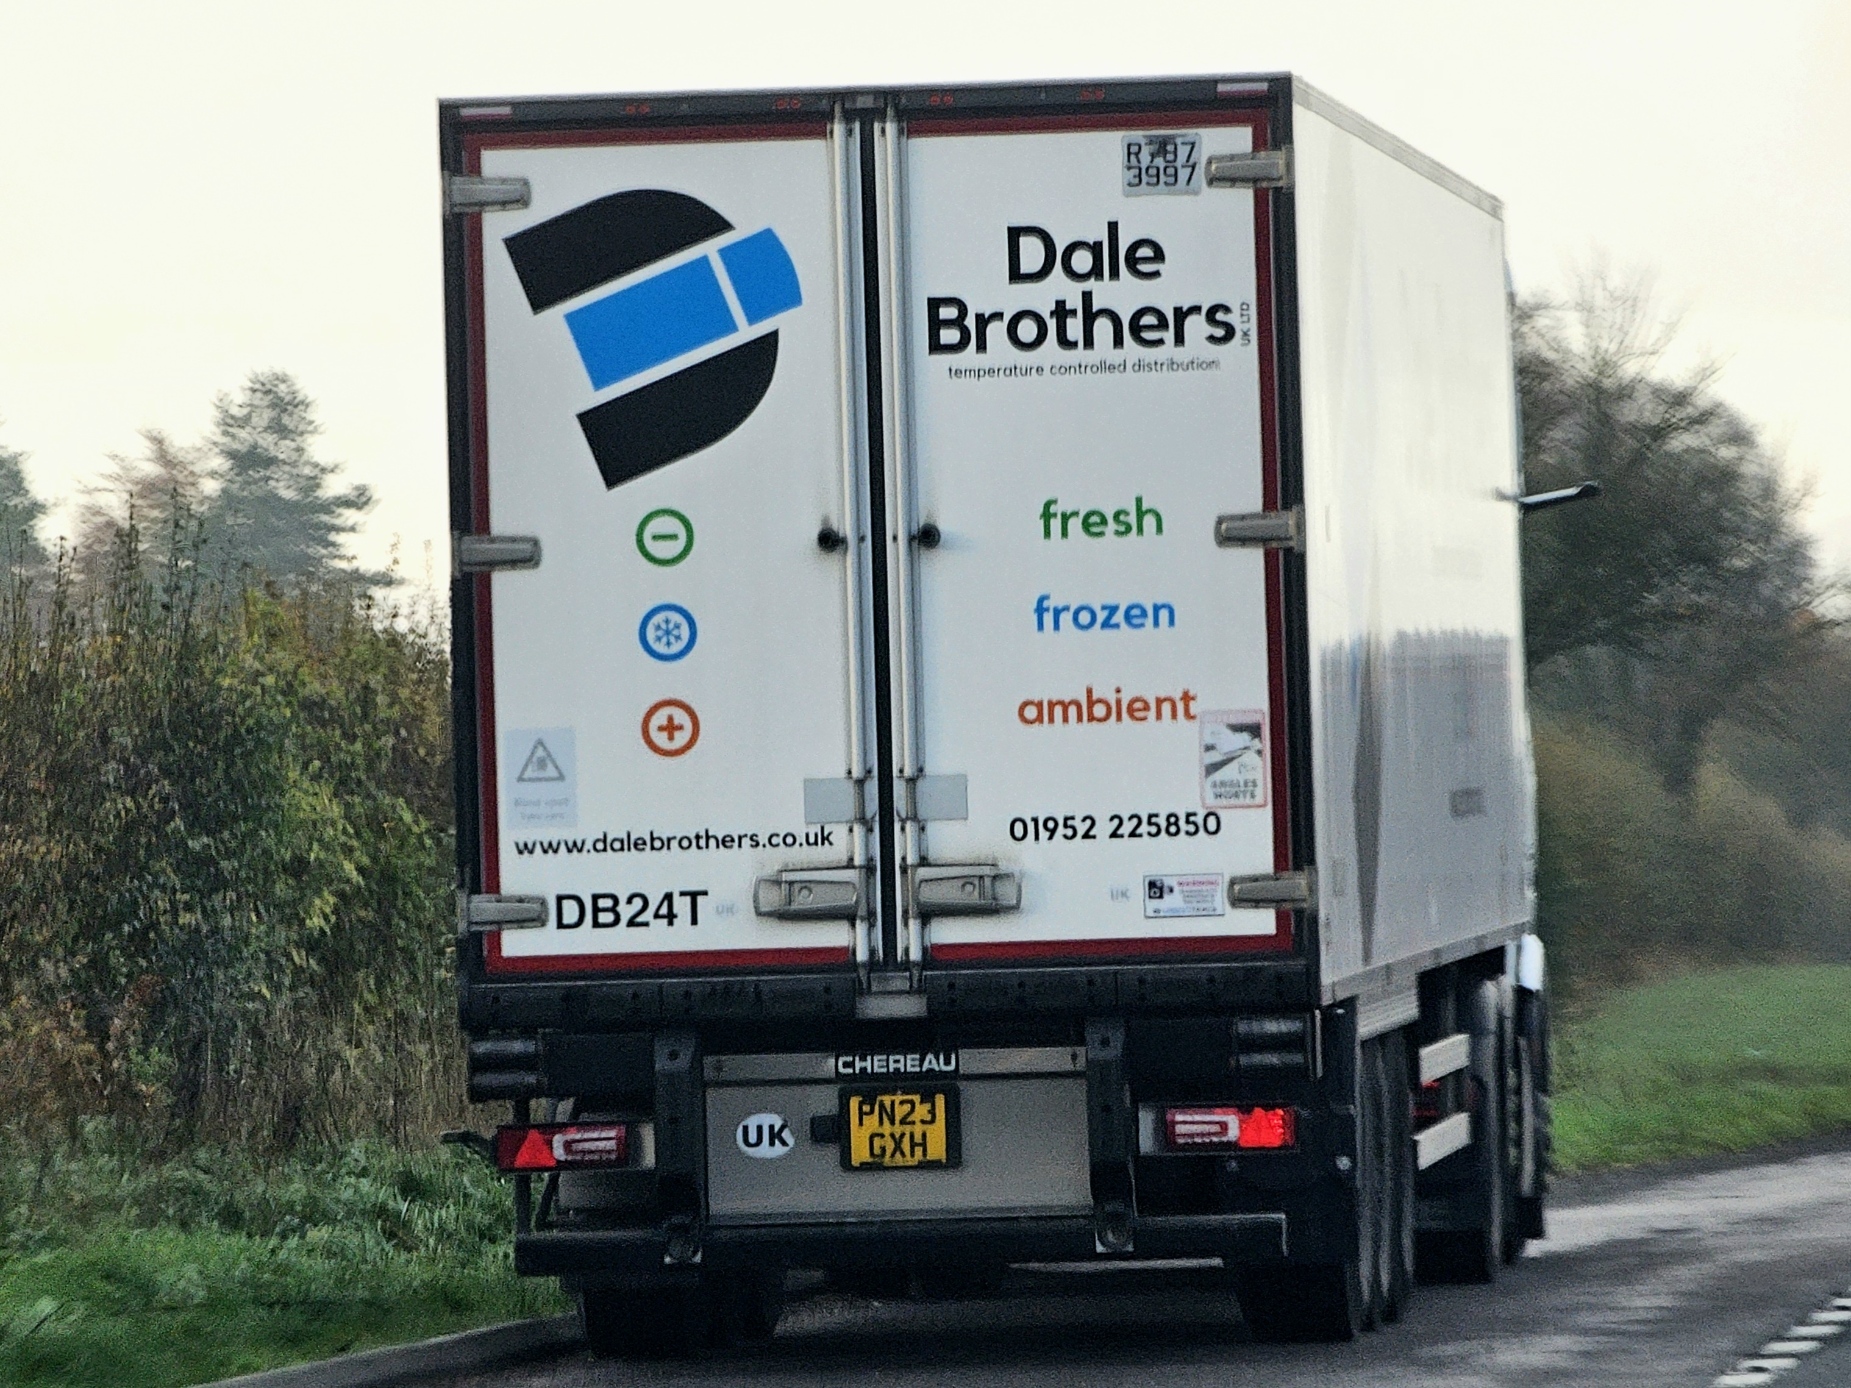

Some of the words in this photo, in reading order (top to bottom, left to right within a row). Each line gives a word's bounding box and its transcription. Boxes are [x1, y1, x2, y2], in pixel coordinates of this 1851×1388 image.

[1126, 165, 1198, 187] 3997
[1006, 220, 1165, 285] Dale
[926, 290, 1237, 356] Brothers
[1240, 302, 1250, 323] LTD
[1240, 325, 1251, 347] UK
[948, 364, 1044, 381] temperature
[1049, 358, 1126, 375] controlled
[1132, 357, 1219, 374] distribution
[1039, 496, 1164, 540] fresh
[1034, 593, 1176, 634] frozen
[1018, 686, 1198, 726] ambient
[515, 826, 834, 856] www.dalebrothers.co.uk
[1009, 815, 1097, 842] 01952
[1109, 811, 1222, 840] 225850
[555, 891, 709, 930] DB24T
[838, 1053, 956, 1075] CHEREAU
[857, 1099, 937, 1127] PN23
[742, 1123, 790, 1149] UK
[868, 1131, 928, 1159] GXH
